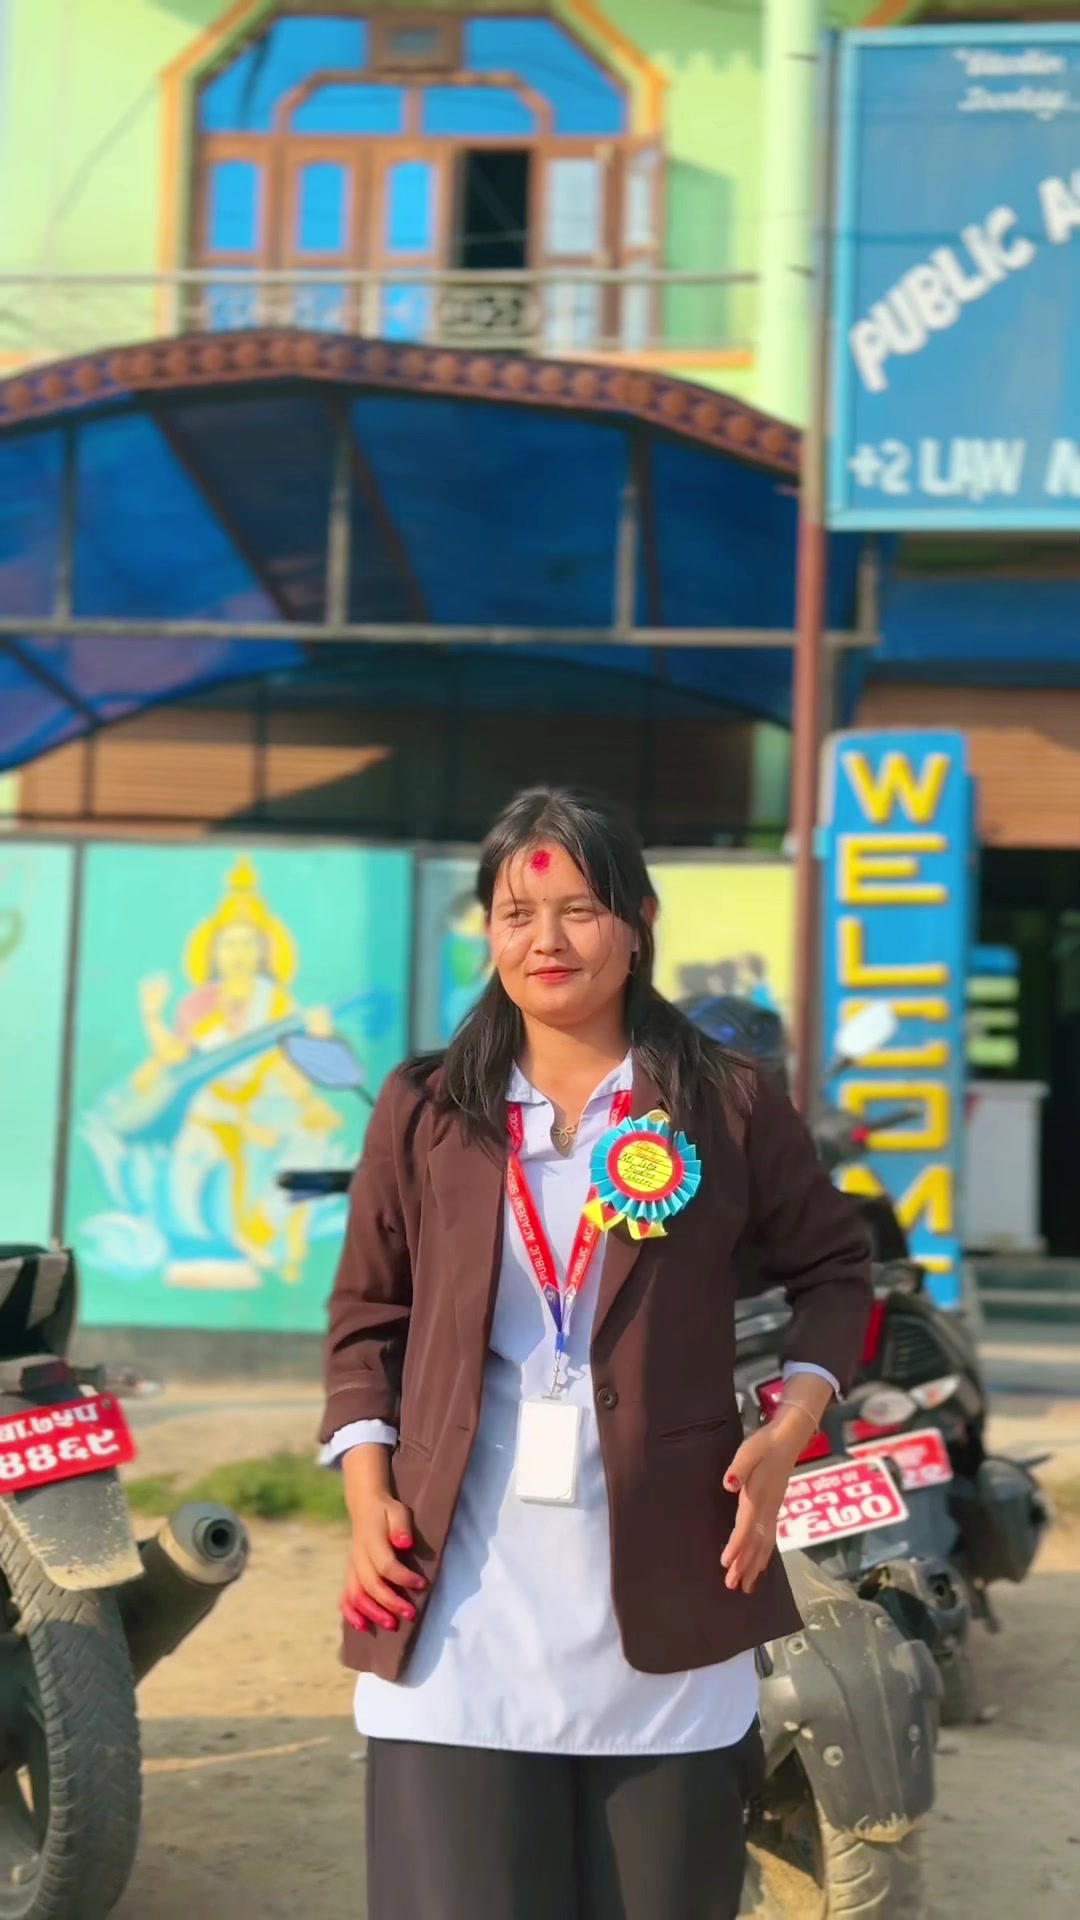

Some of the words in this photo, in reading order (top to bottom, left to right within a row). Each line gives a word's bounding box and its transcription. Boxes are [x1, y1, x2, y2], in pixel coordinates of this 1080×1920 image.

[850, 205, 1036, 393] PUBLIC
[1038, 168, 1080, 244] A
[849, 438, 911, 496] +2
[919, 434, 1027, 498] LAW
[838, 752, 955, 1272] WELCOM
[513, 1197, 536, 1241] ACADEMY
[530, 1245, 548, 1281] PUBLIC
[571, 1246, 588, 1283] PUBLIC
[778, 1494, 893, 1536] ६७०
